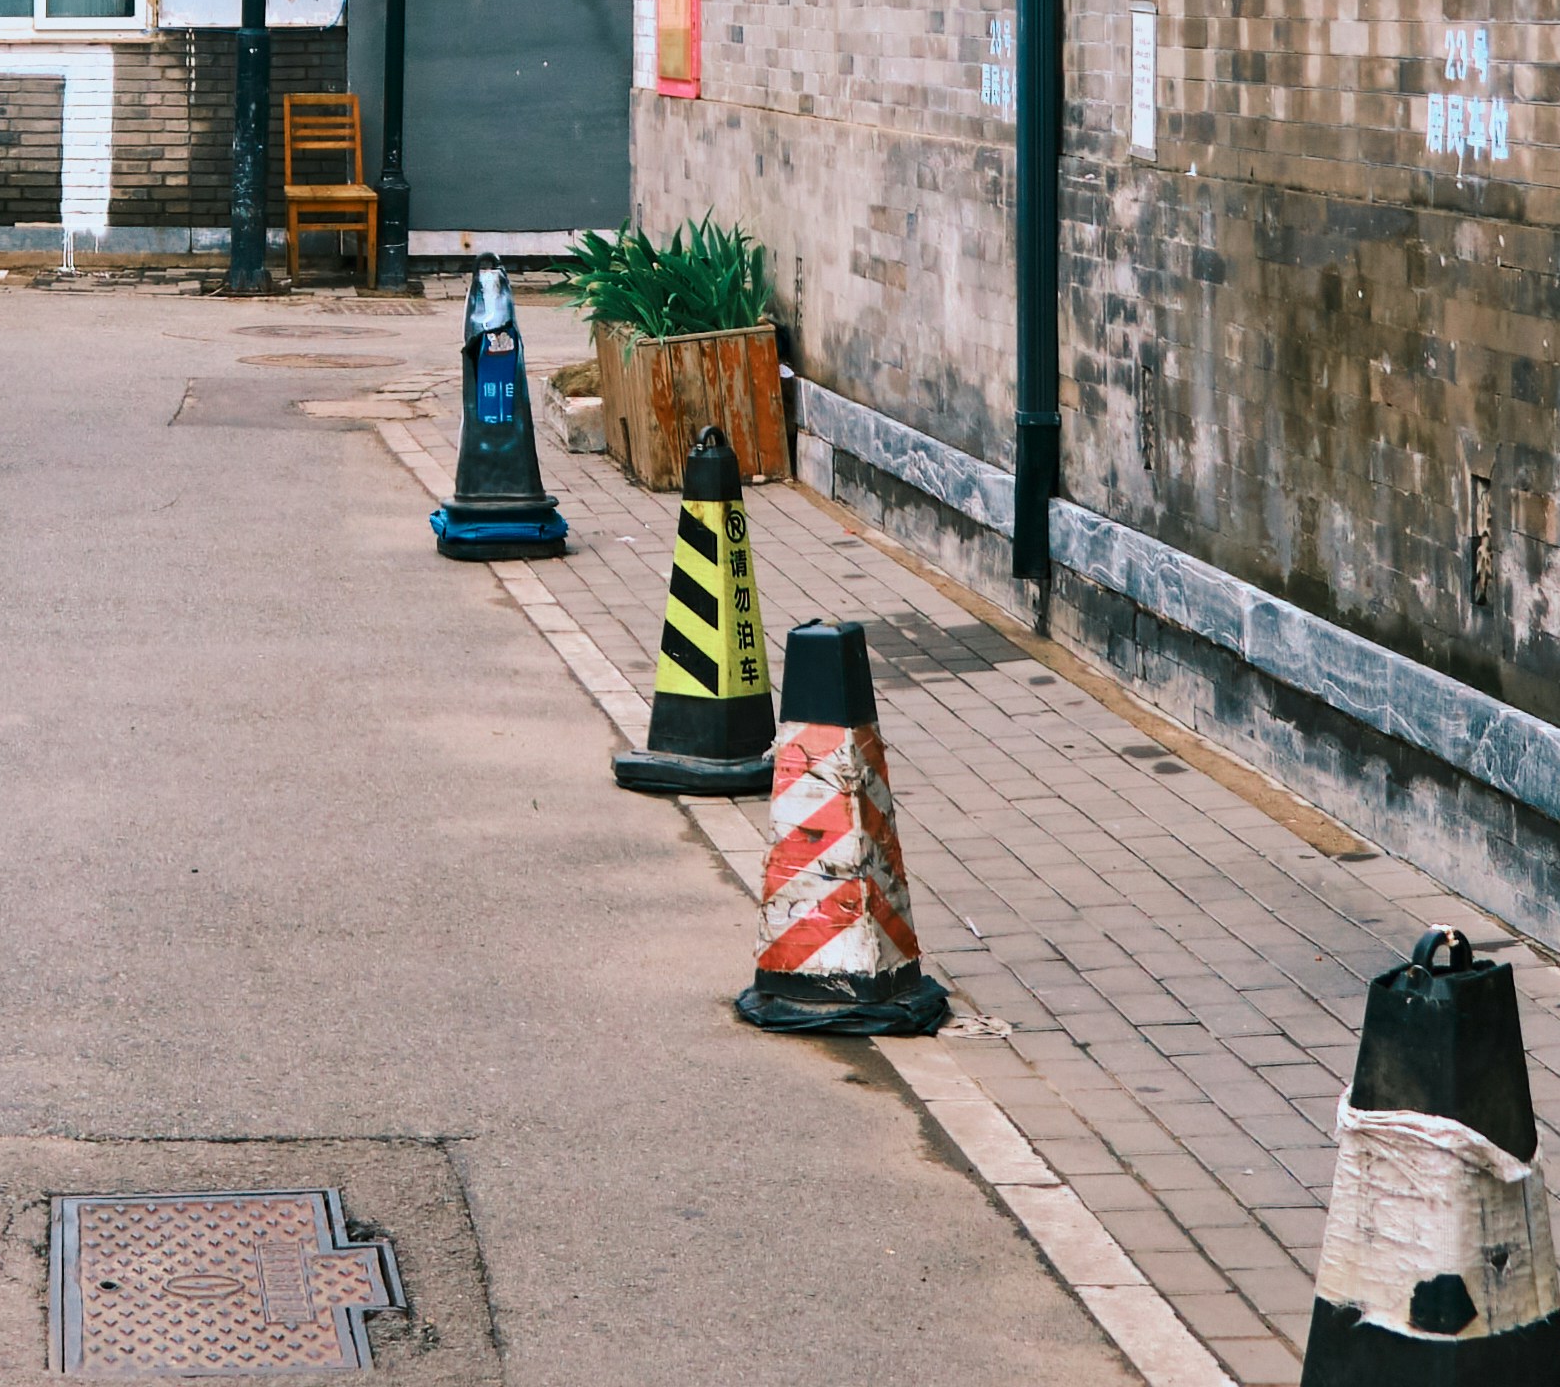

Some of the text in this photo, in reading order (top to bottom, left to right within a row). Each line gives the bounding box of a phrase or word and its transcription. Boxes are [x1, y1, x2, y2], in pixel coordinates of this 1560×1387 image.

[1444, 29, 1488, 83] 23号
[1426, 93, 1509, 161] 居民车位
[730, 548, 759, 686] 请勿泊车
